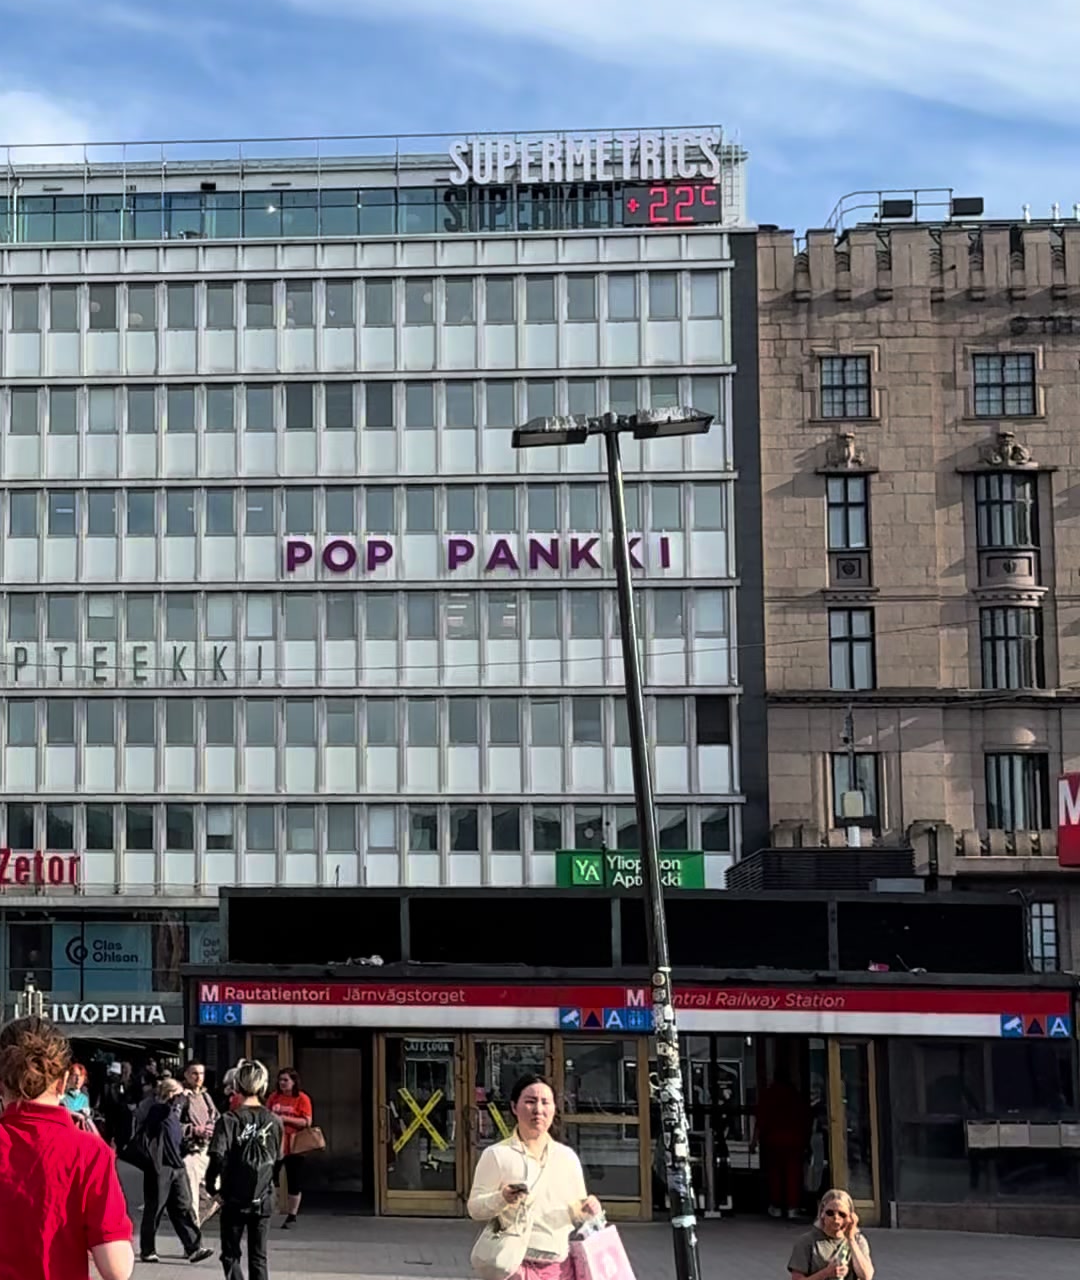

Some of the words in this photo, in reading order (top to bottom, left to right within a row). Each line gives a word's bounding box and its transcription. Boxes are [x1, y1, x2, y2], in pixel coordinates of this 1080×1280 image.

[448, 132, 721, 185] SUPERMETRICS
[286, 539, 394, 572] POP
[447, 535, 671, 571] PANKKI
[607, 855, 681, 873] Yliopon
[92, 939, 122, 952] Clas
[92, 951, 139, 964] Ohlson
[201, 984, 220, 1002] M
[224, 986, 331, 1001] Rautatientori
[342, 987, 466, 1005] Järnvägstorget
[627, 989, 645, 1007] M
[668, 991, 712, 1006] ntral
[715, 991, 780, 1009] Railway
[785, 991, 846, 1008] Station
[14, 1003, 167, 1023] IVOPIHA
